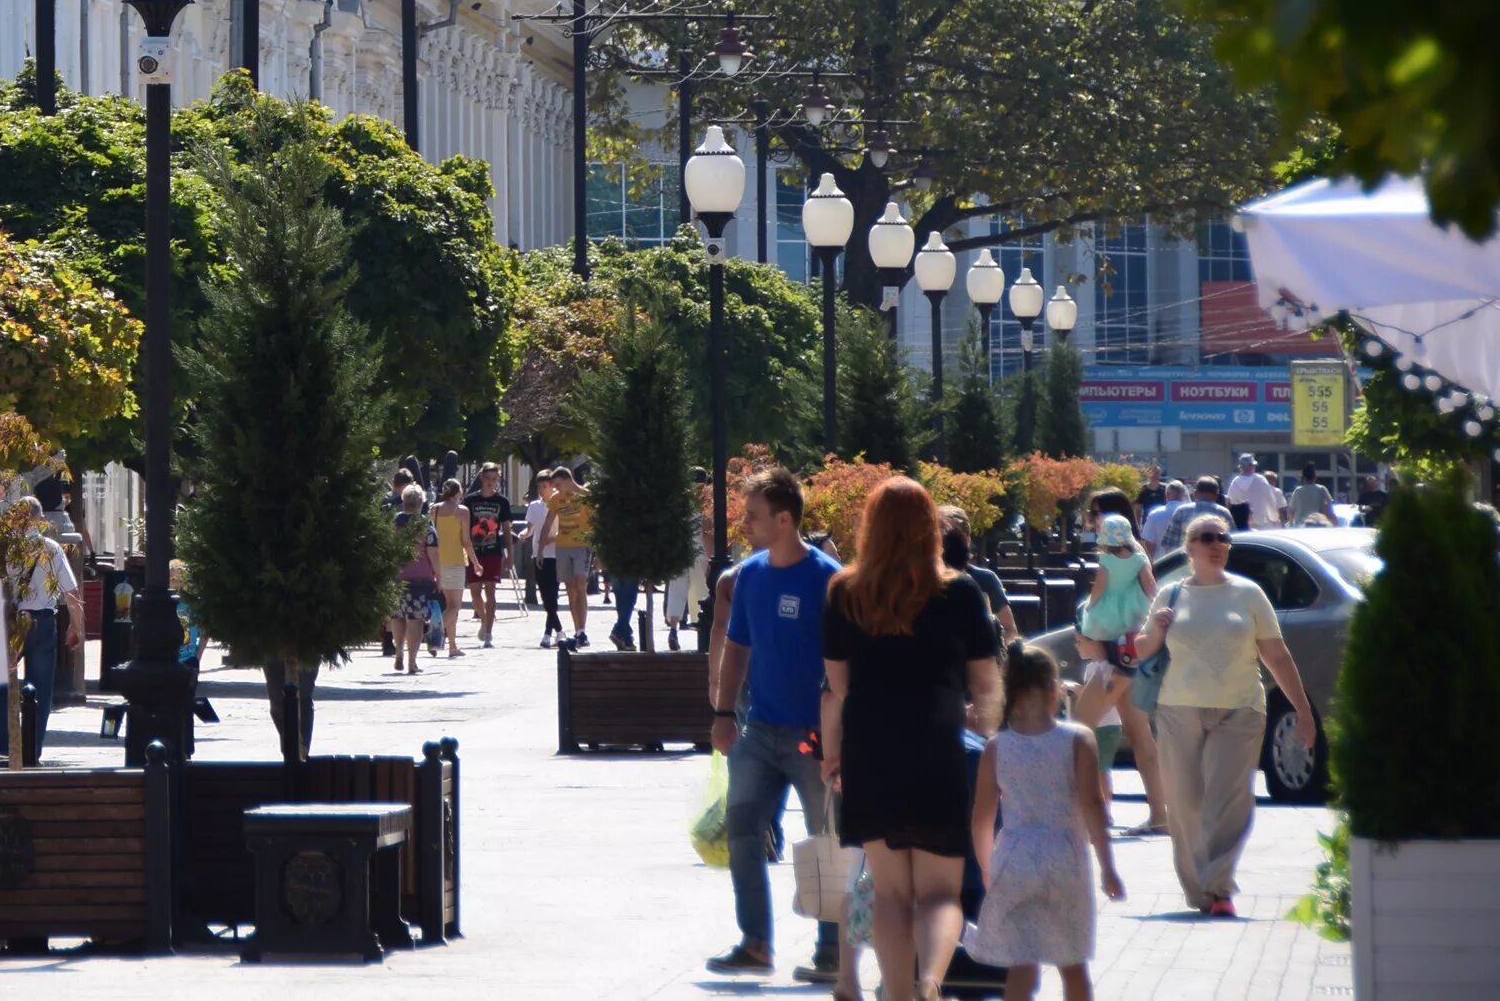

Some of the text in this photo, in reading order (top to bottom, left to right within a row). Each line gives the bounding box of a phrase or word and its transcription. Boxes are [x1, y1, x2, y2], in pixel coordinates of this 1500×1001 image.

[1078, 385, 1157, 397] МПЬЮТЕРЫ
[1179, 386, 1250, 398] НОУТБУКИ
[1272, 386, 1291, 398] ПЛ
[1307, 385, 1333, 398] 555
[1311, 400, 1329, 413] 55
[1179, 410, 1227, 420] lenovo
[1267, 411, 1291, 422] DEL
[1312, 416, 1329, 429] 55
